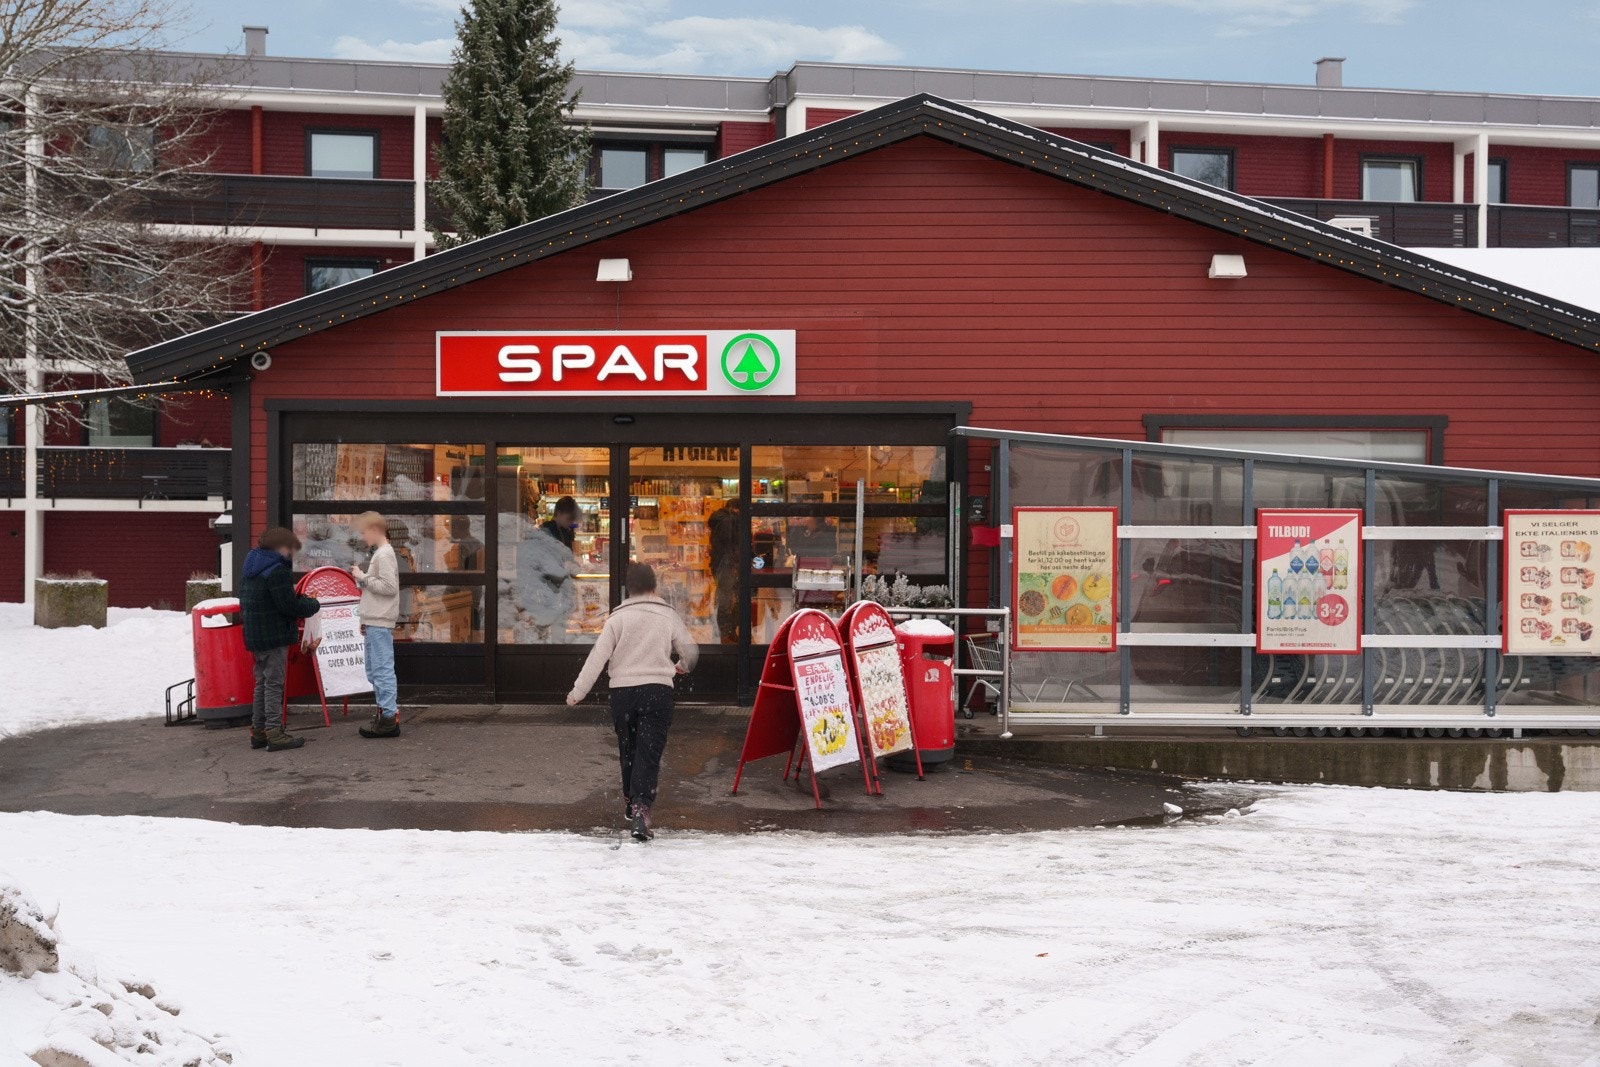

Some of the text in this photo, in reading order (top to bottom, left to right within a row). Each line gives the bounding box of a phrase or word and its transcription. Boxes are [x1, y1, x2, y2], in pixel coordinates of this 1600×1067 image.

[498, 345, 698, 382] SPAR
[663, 446, 738, 461] HYGIENE
[1268, 526, 1310, 538] TILBUD!
[1320, 603, 1330, 618] 3
[1335, 603, 1344, 618] 2
[318, 642, 364, 655] DELTIDSANSAT
[346, 657, 355, 667] 18
[805, 672, 835, 686] ENDELIG
